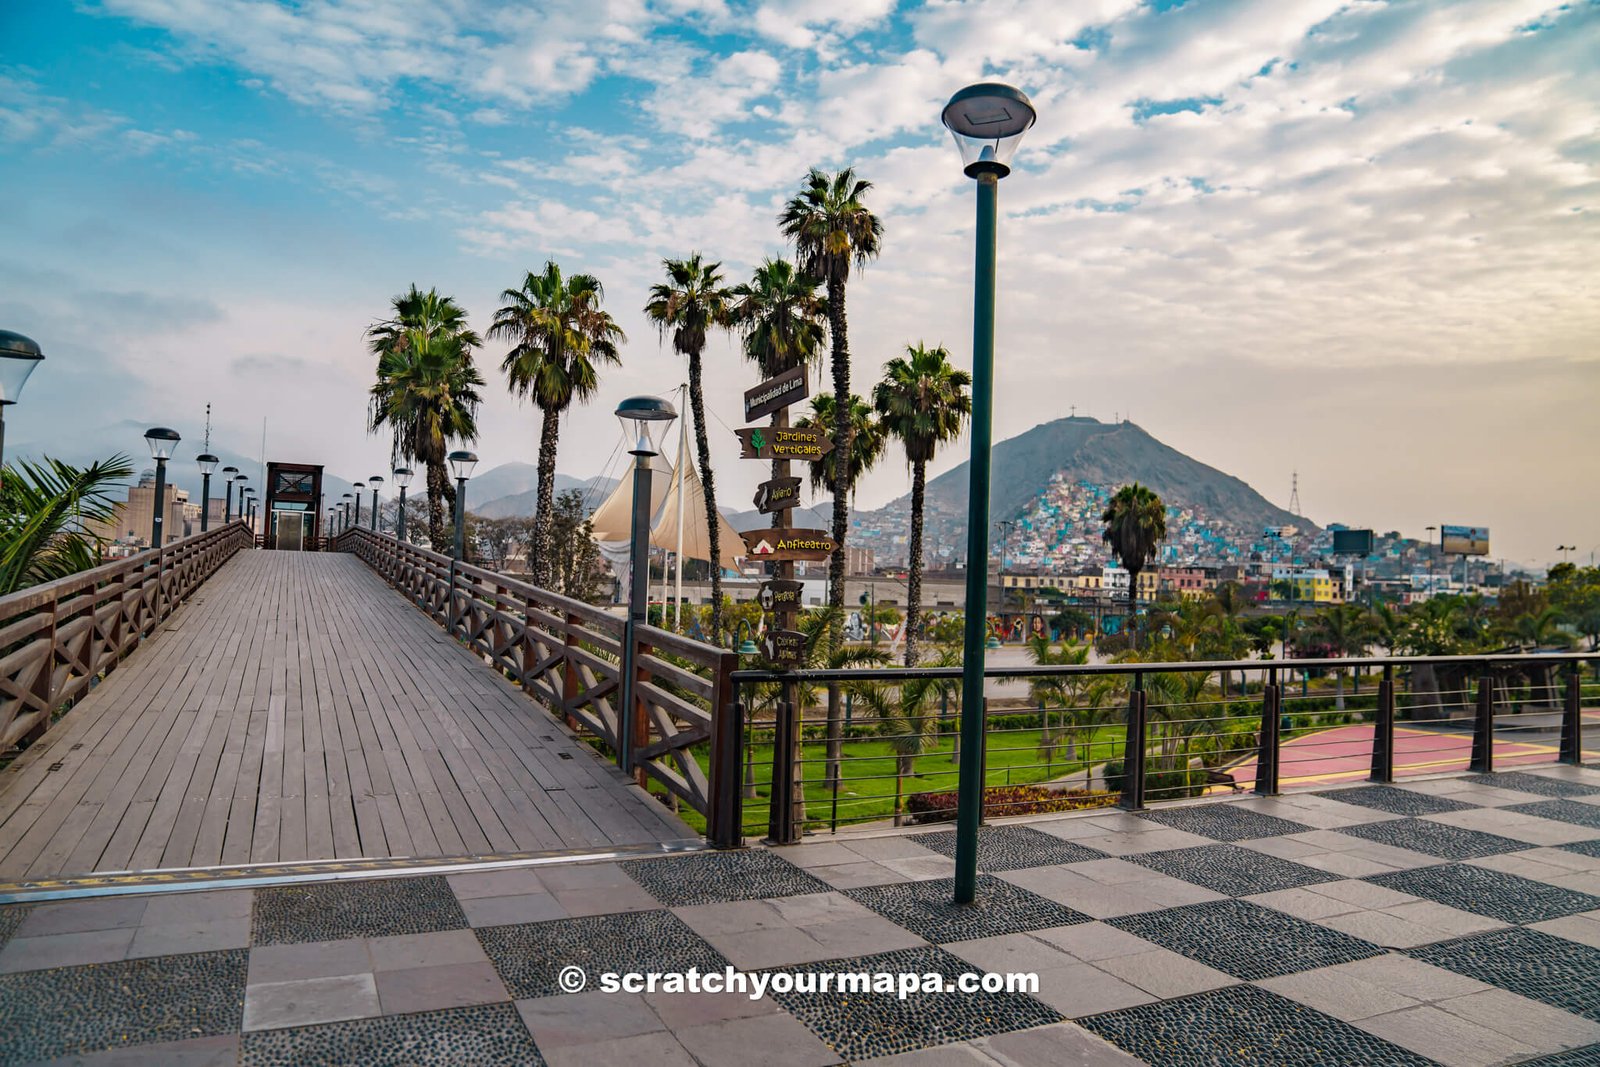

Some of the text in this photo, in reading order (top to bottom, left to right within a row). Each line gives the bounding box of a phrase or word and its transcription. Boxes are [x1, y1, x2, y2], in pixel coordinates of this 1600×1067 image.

[750, 377, 803, 408] Municipalidad de Lima
[776, 431, 817, 443] Jardines
[773, 444, 821, 455] Verticales
[777, 538, 831, 550] Anfiteatro
